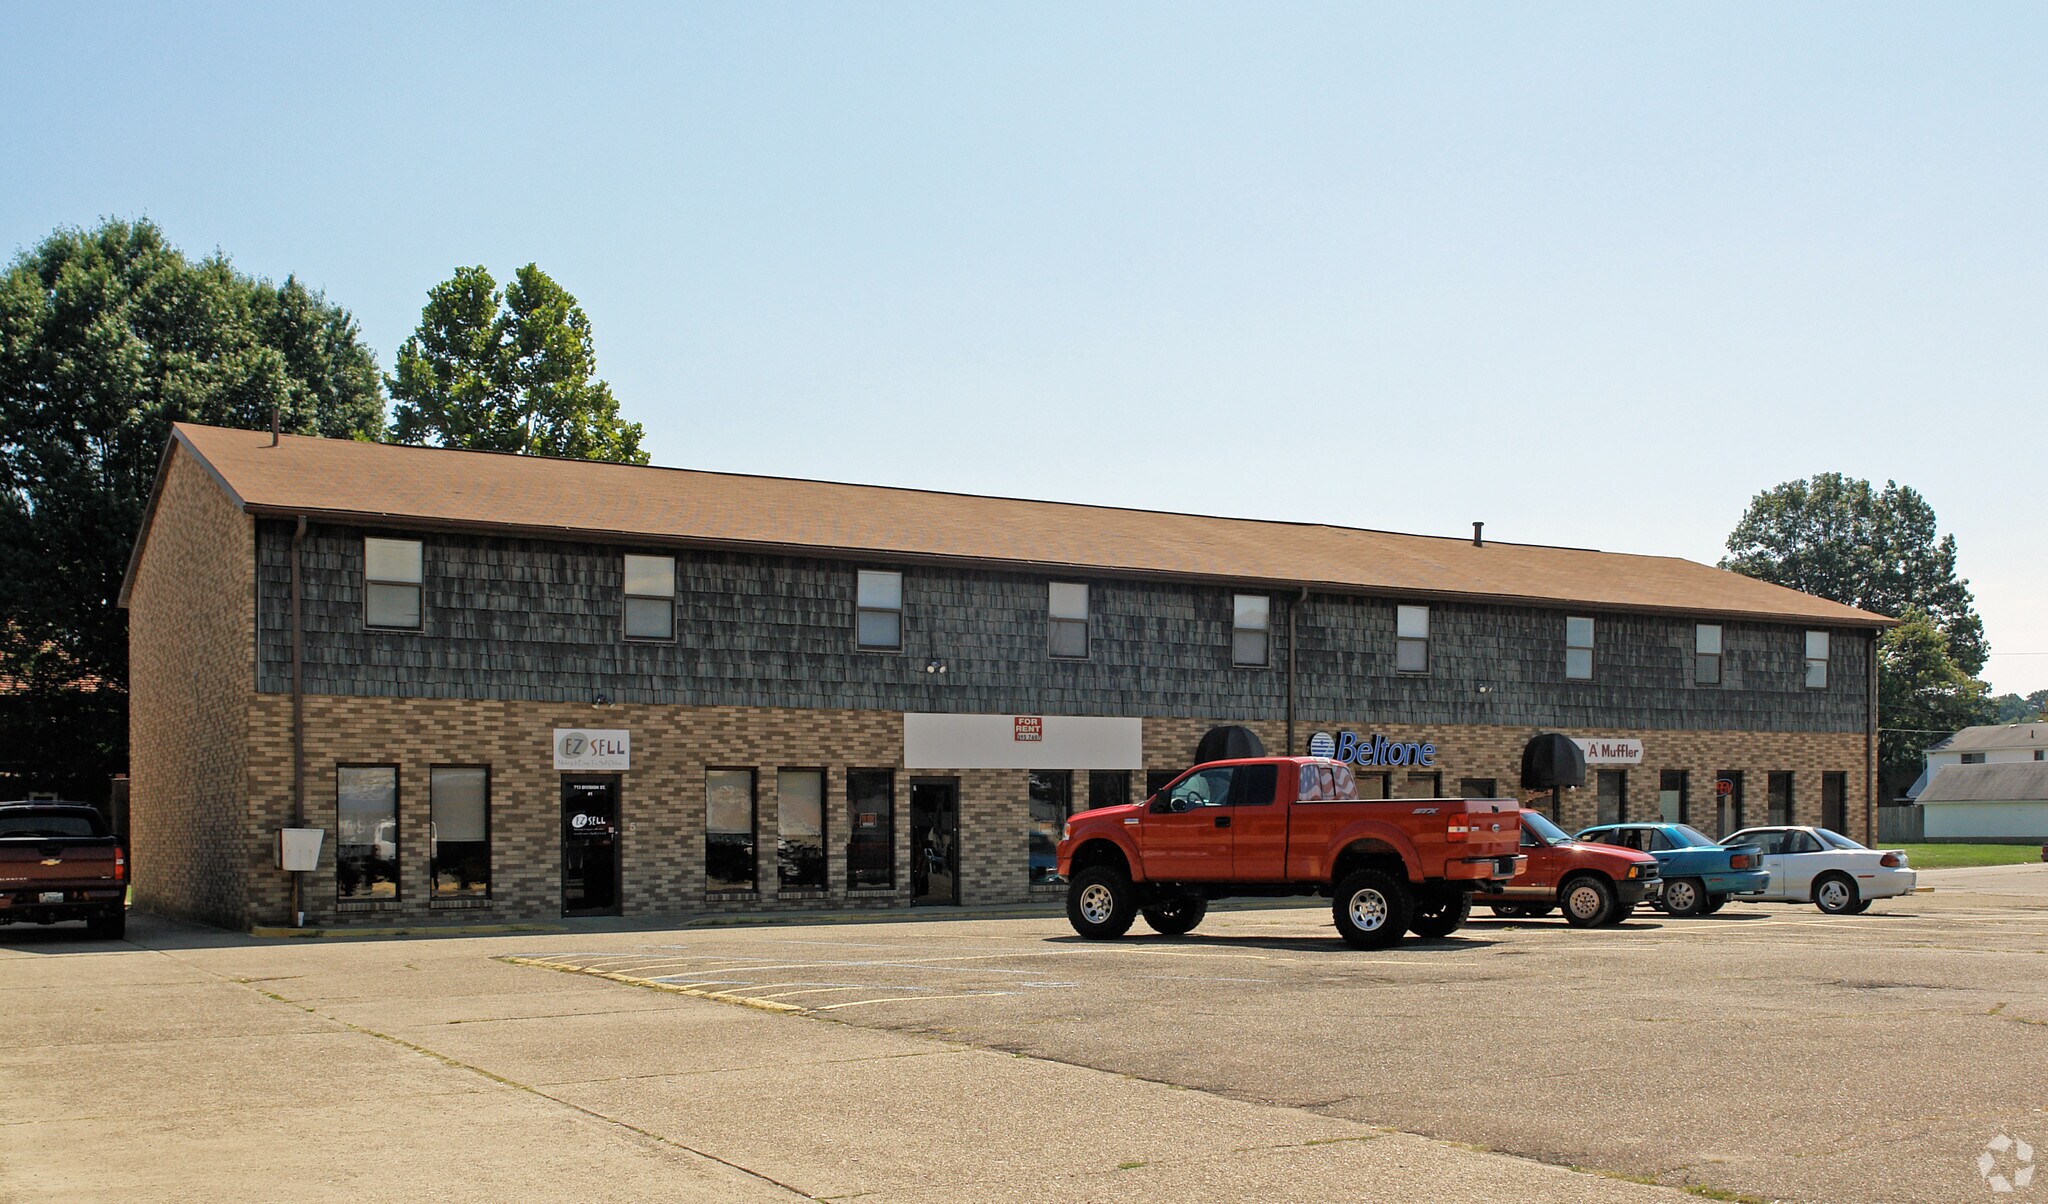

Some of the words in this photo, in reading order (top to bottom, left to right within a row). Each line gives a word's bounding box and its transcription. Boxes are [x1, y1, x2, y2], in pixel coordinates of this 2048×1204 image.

[565, 738, 584, 756] EZ
[590, 739, 625, 757] SELL
[1337, 731, 1435, 766] Beltone
[1601, 744, 1639, 758] Muffler
[576, 816, 585, 825] EZ
[588, 816, 606, 825] SELL
